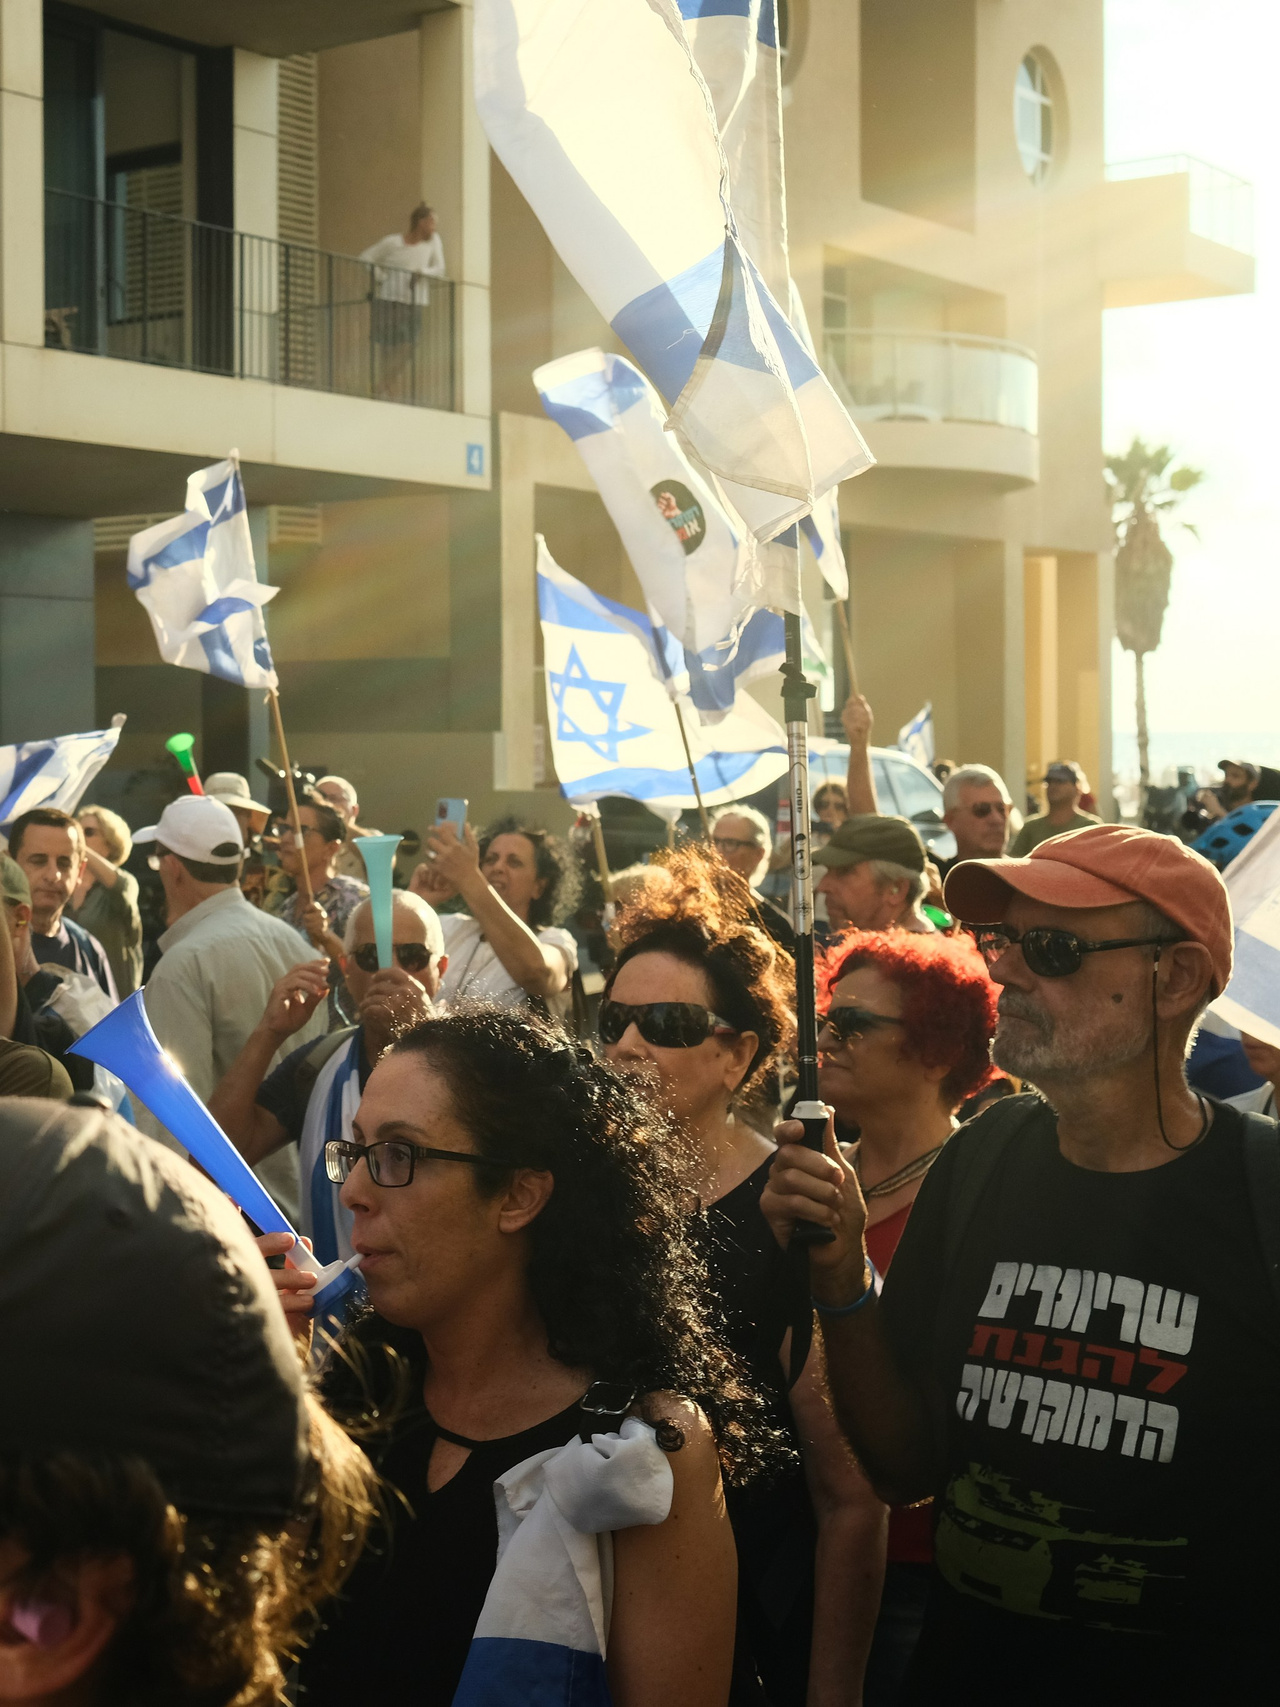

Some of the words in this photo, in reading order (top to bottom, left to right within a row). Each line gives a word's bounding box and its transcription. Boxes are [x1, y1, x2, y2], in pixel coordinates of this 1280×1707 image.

[977, 1261, 1199, 1356] שריונרים
[967, 1323, 1188, 1393] להגנת
[956, 1363, 1180, 1463] הדמוקרטיה
